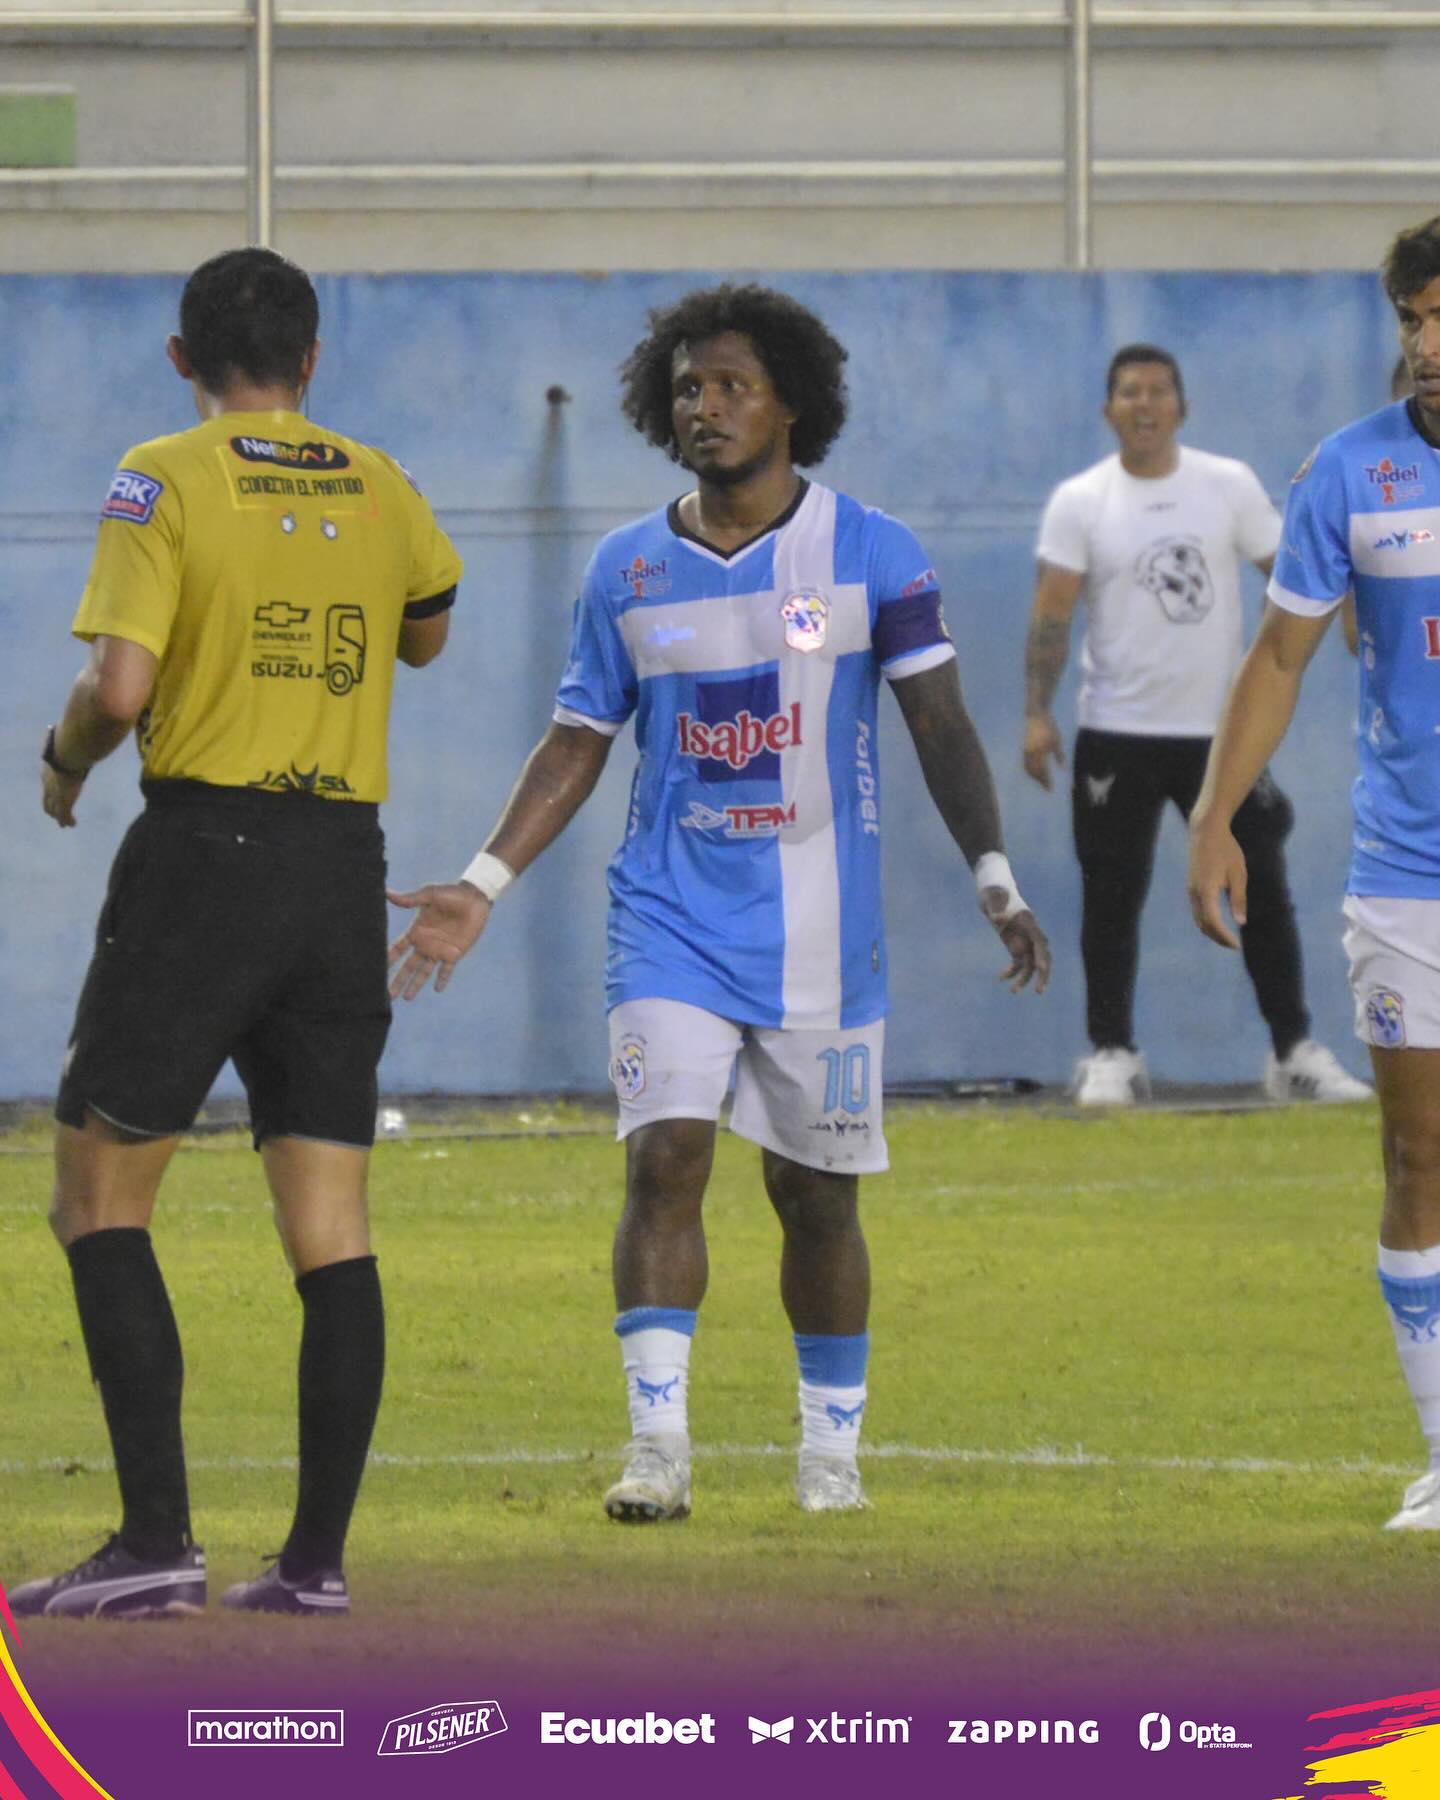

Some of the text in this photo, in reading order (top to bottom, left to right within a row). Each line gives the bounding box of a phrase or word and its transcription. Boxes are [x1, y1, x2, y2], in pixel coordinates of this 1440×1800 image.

[238, 475, 364, 496] CONECTA EL PARTIDO
[1364, 464, 1419, 484] Tadel
[620, 560, 667, 583] Tadel
[251, 661, 313, 678] ISUZU
[677, 701, 803, 768] Isabel
[725, 801, 796, 830] TPM
[817, 1043, 870, 1114] 10
